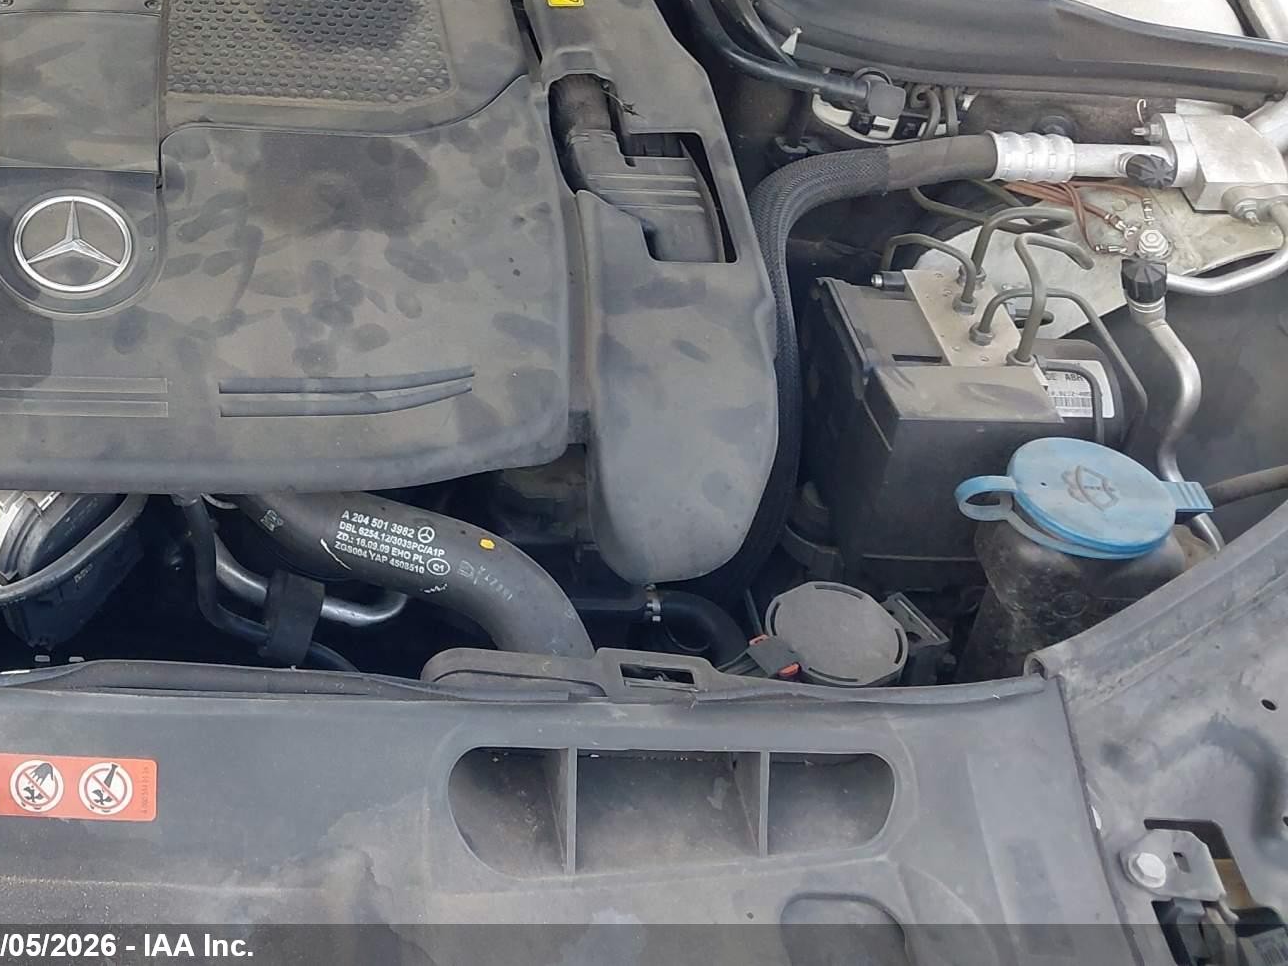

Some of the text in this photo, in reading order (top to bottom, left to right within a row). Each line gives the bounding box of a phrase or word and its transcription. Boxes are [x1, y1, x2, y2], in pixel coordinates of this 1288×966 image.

[339, 521, 357, 532] DBL
[341, 510, 415, 538] A 204 501 3982
[368, 550, 388, 563] YAP
[391, 547, 411, 558] EHO
[412, 553, 425, 564] PL
